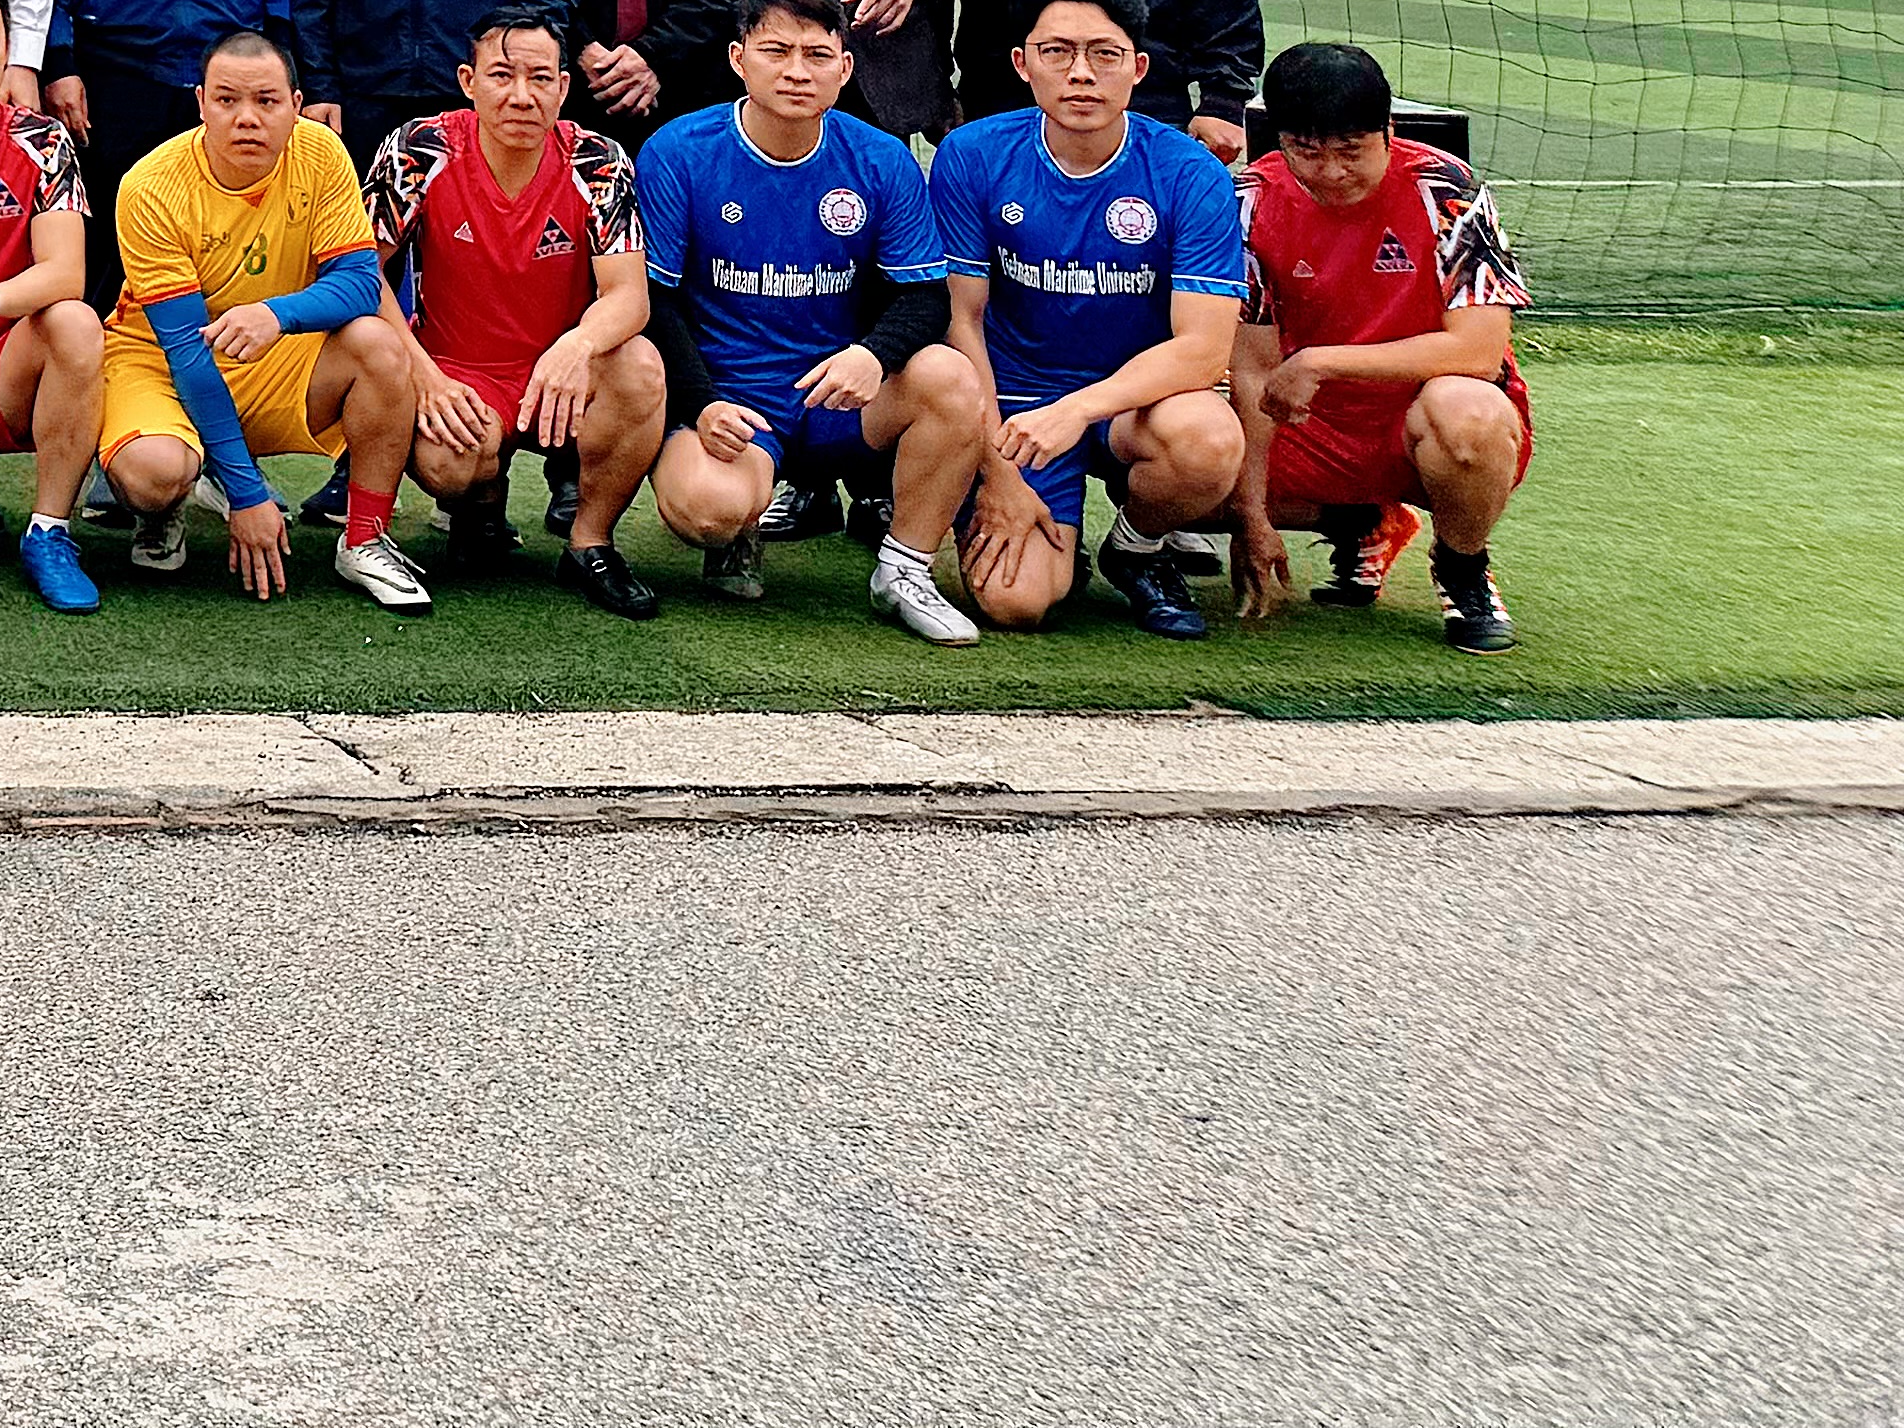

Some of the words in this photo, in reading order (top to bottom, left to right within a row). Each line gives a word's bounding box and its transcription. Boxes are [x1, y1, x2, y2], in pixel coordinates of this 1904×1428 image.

[243, 232, 269, 276] 8
[711, 257, 760, 295] Vietnam
[761, 262, 815, 298] Maritime
[1042, 258, 1096, 296] Maritime
[1096, 261, 1157, 296] University
